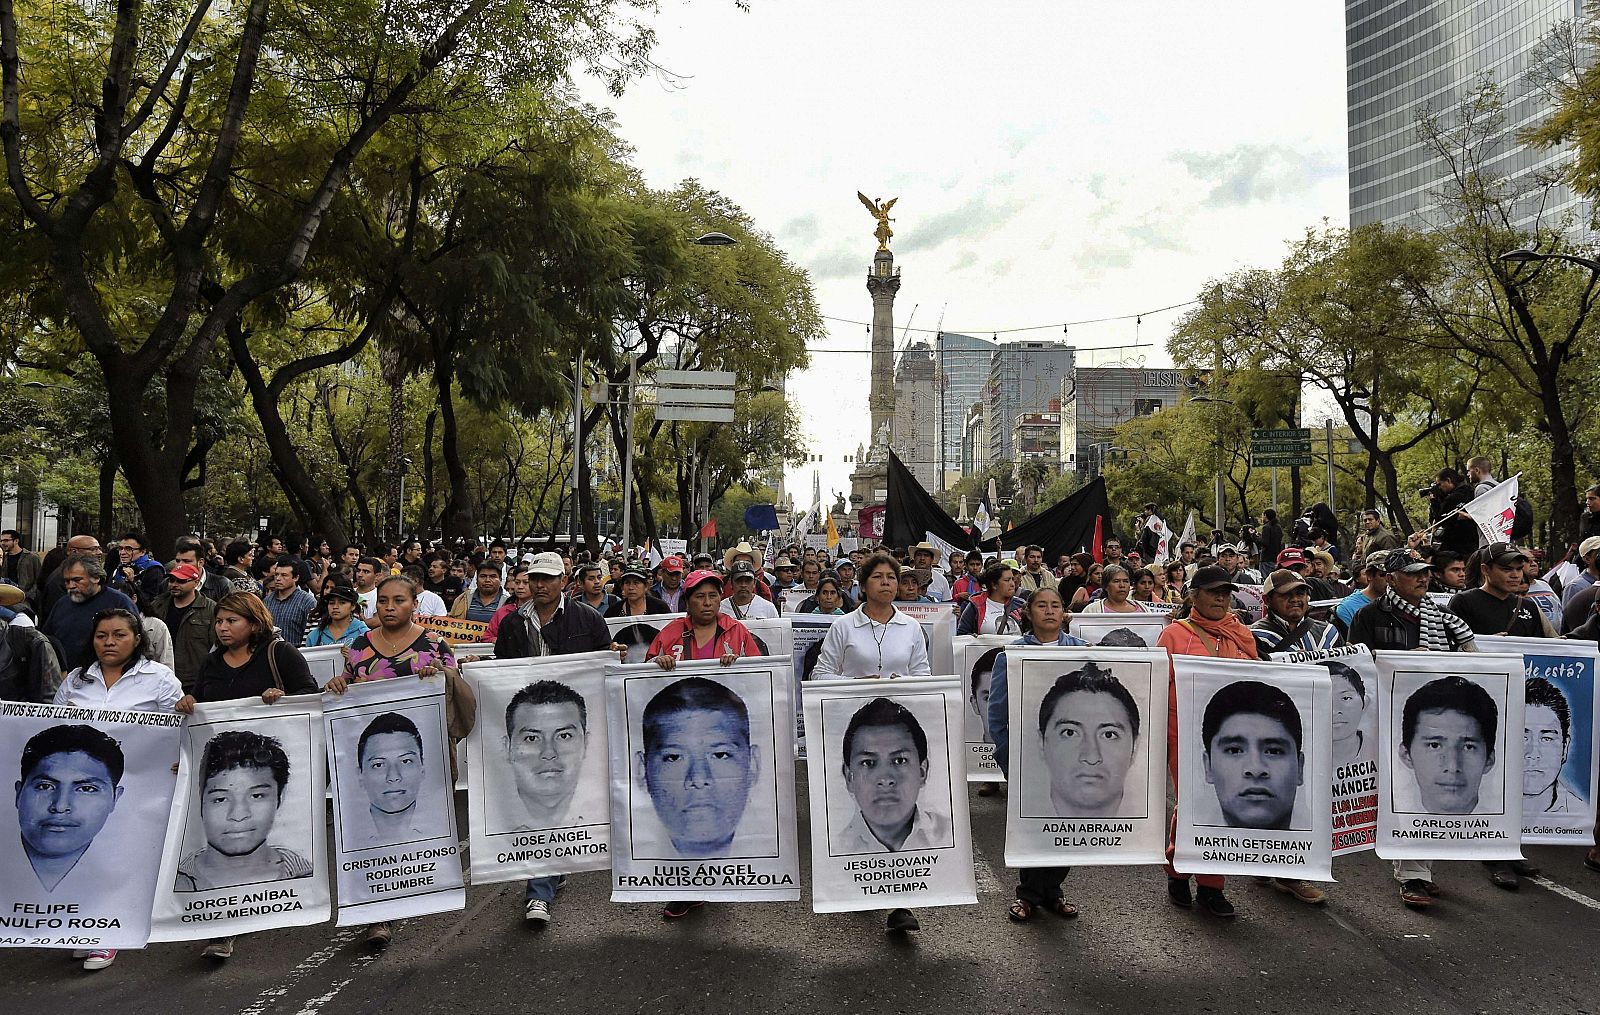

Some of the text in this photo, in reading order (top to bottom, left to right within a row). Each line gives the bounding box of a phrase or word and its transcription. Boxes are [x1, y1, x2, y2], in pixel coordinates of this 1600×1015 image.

[1143, 371, 1199, 388] HSBC
[450, 621, 464, 630] SE
[465, 622, 483, 632] LOS
[453, 632, 474, 641] LOS
[1525, 660, 1585, 679] de está?
[25, 705, 37, 717] SE
[37, 706, 53, 719] LOS
[53, 707, 97, 723] LLEVARON,
[98, 710, 121, 723] VIVOS
[121, 711, 137, 724] LOS
[1042, 821, 1133, 833] ADÁN ABRAJAN
[1412, 819, 1489, 829] CARLOS IVÁN
[1555, 826, 1583, 835] Garnica
[512, 830, 592, 847] JOSE ÁNGEL
[1054, 837, 1122, 846] DE LA CRUZ
[1339, 830, 1367, 847] SOMOS
[1392, 829, 1509, 840] RAMÍREZ VILLAREAL
[1194, 836, 1313, 851] MARTÍN GETSEMANY
[342, 846, 457, 872] CRISTIAN ALFONSO
[497, 843, 608, 864] CAMPOS CANTOR
[1202, 849, 1306, 865] SÁNCHEZ GARCÍA
[654, 863, 756, 876] LUIS ÁNGEL
[843, 855, 939, 871] JESÚS JOVANY
[366, 862, 436, 881] RODRÍGUEZ
[854, 867, 931, 882] RODRÍGUEZ
[369, 875, 434, 894] TELUMBRE
[618, 874, 794, 887] FRANCISCO ARZOLA
[861, 881, 928, 895] TLATEMPA
[184, 888, 298, 911] JORGE ANÍBAL
[13, 902, 79, 914] FELIPE
[181, 901, 303, 923] CRUZ MENDOZA
[0, 917, 121, 929] NULFO ROSA
[30, 937, 51, 945] 20
[54, 935, 101, 945] AÑOS
